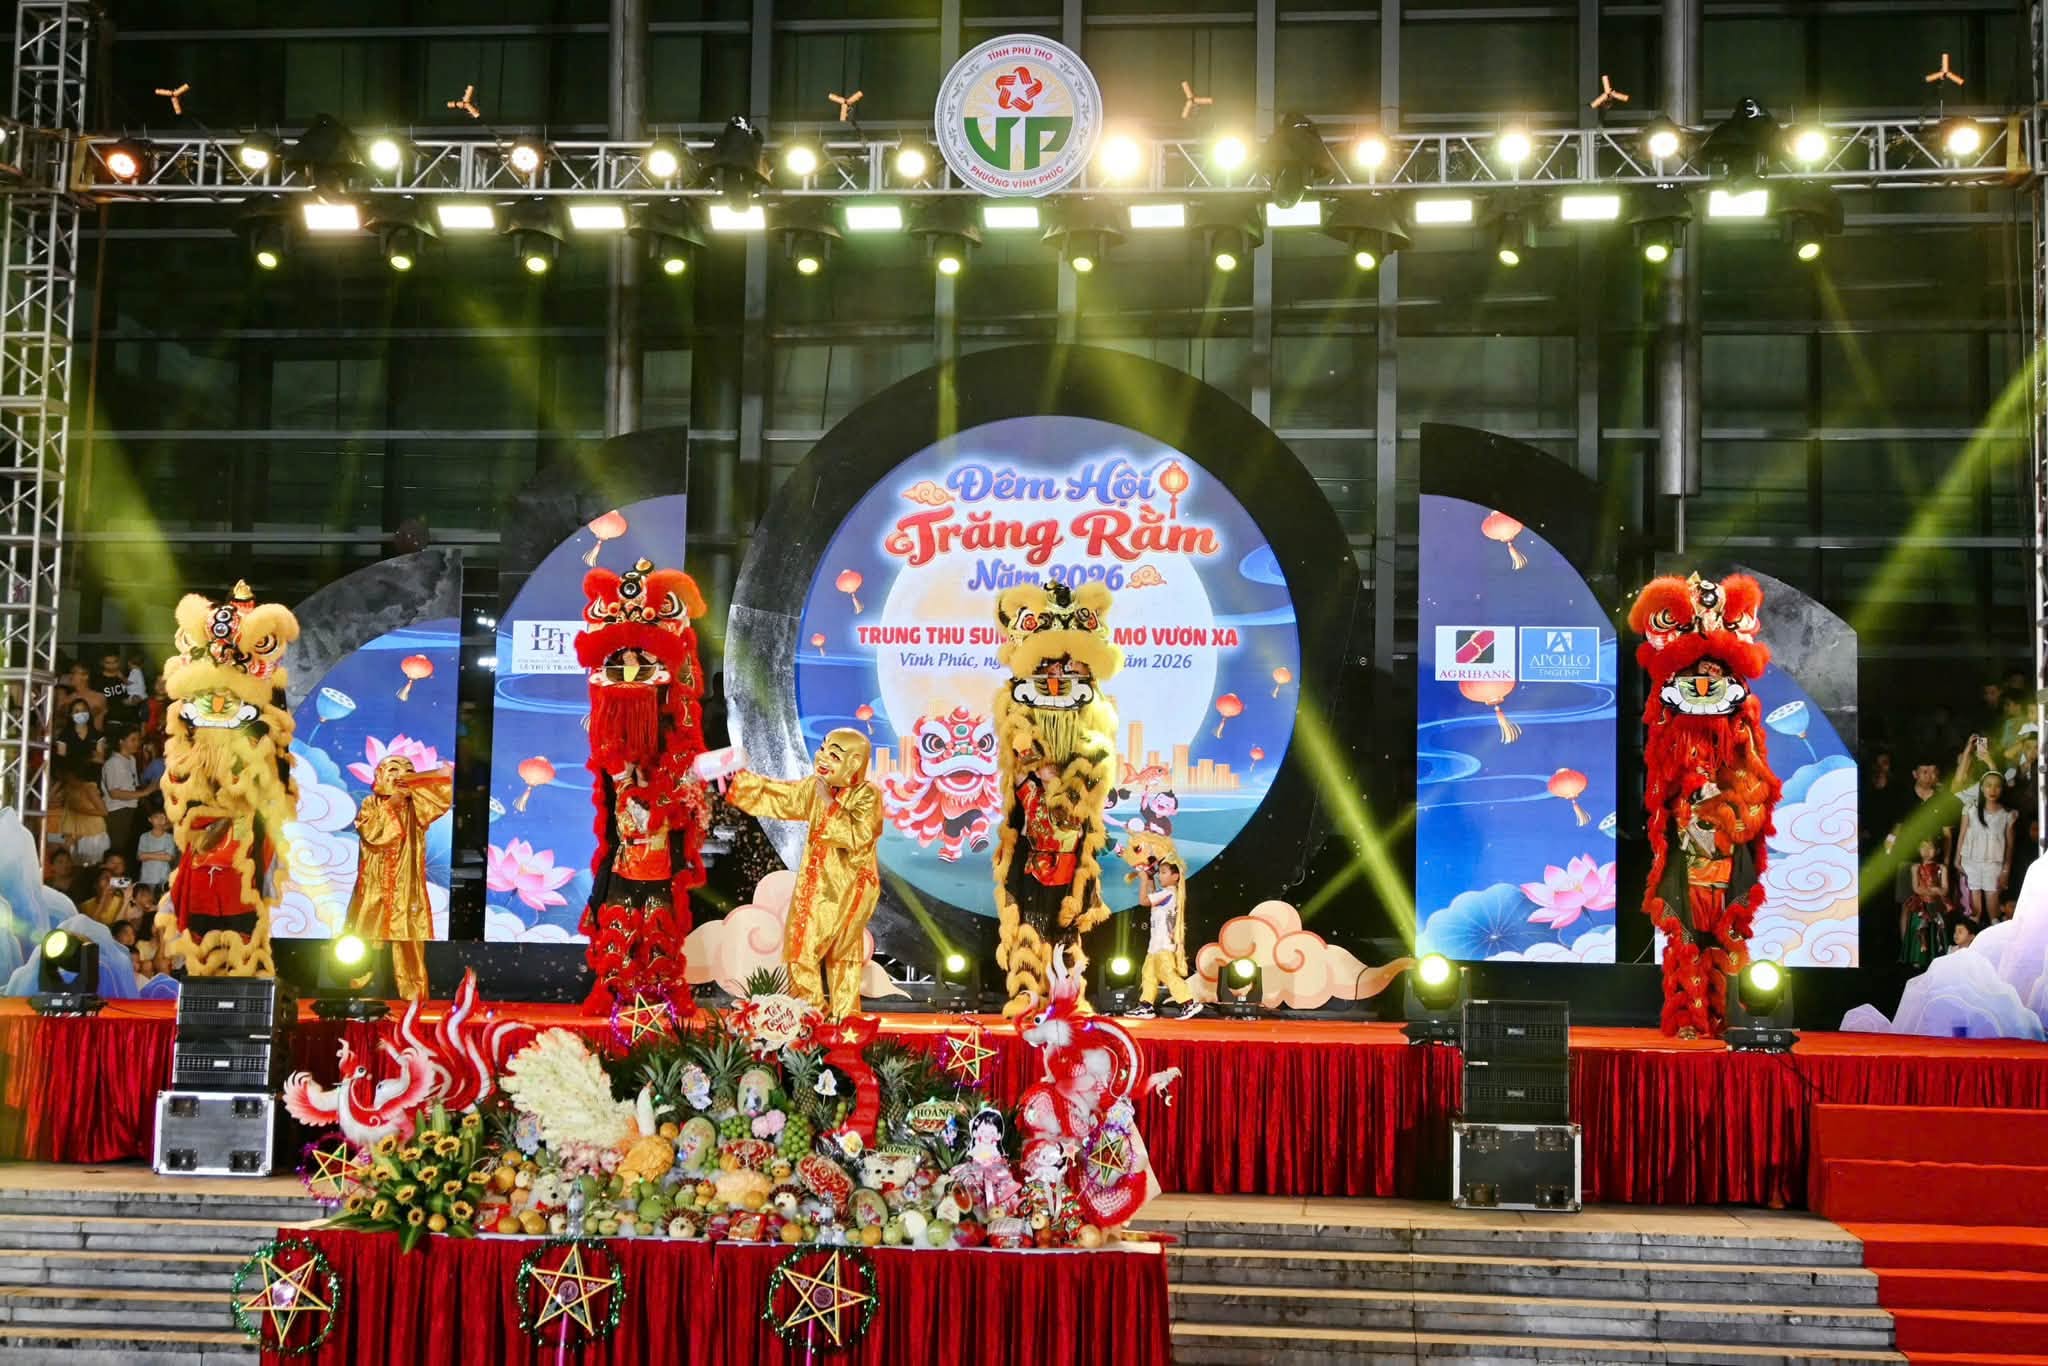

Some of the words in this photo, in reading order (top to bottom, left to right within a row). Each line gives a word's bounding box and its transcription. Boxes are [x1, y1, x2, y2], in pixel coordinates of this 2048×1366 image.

[947, 463, 1059, 502] Đêm
[1066, 458, 1157, 508] Hội
[884, 505, 1064, 567] Trăng
[1070, 503, 1220, 561] Rằm
[967, 558, 1040, 591] Năm
[857, 626, 921, 645] TRUNG
[926, 626, 965, 645] THU
[1113, 625, 1147, 646] MƠ
[1151, 625, 1207, 646] VƯƠN
[1211, 627, 1239, 646] XA
[900, 652, 933, 667] Vĩnh
[938, 651, 978, 669] Phúc,
[1152, 653, 1192, 668] 2026
[1529, 654, 1591, 667] APOLLO
[1440, 669, 1512, 680] AGRIBANK
